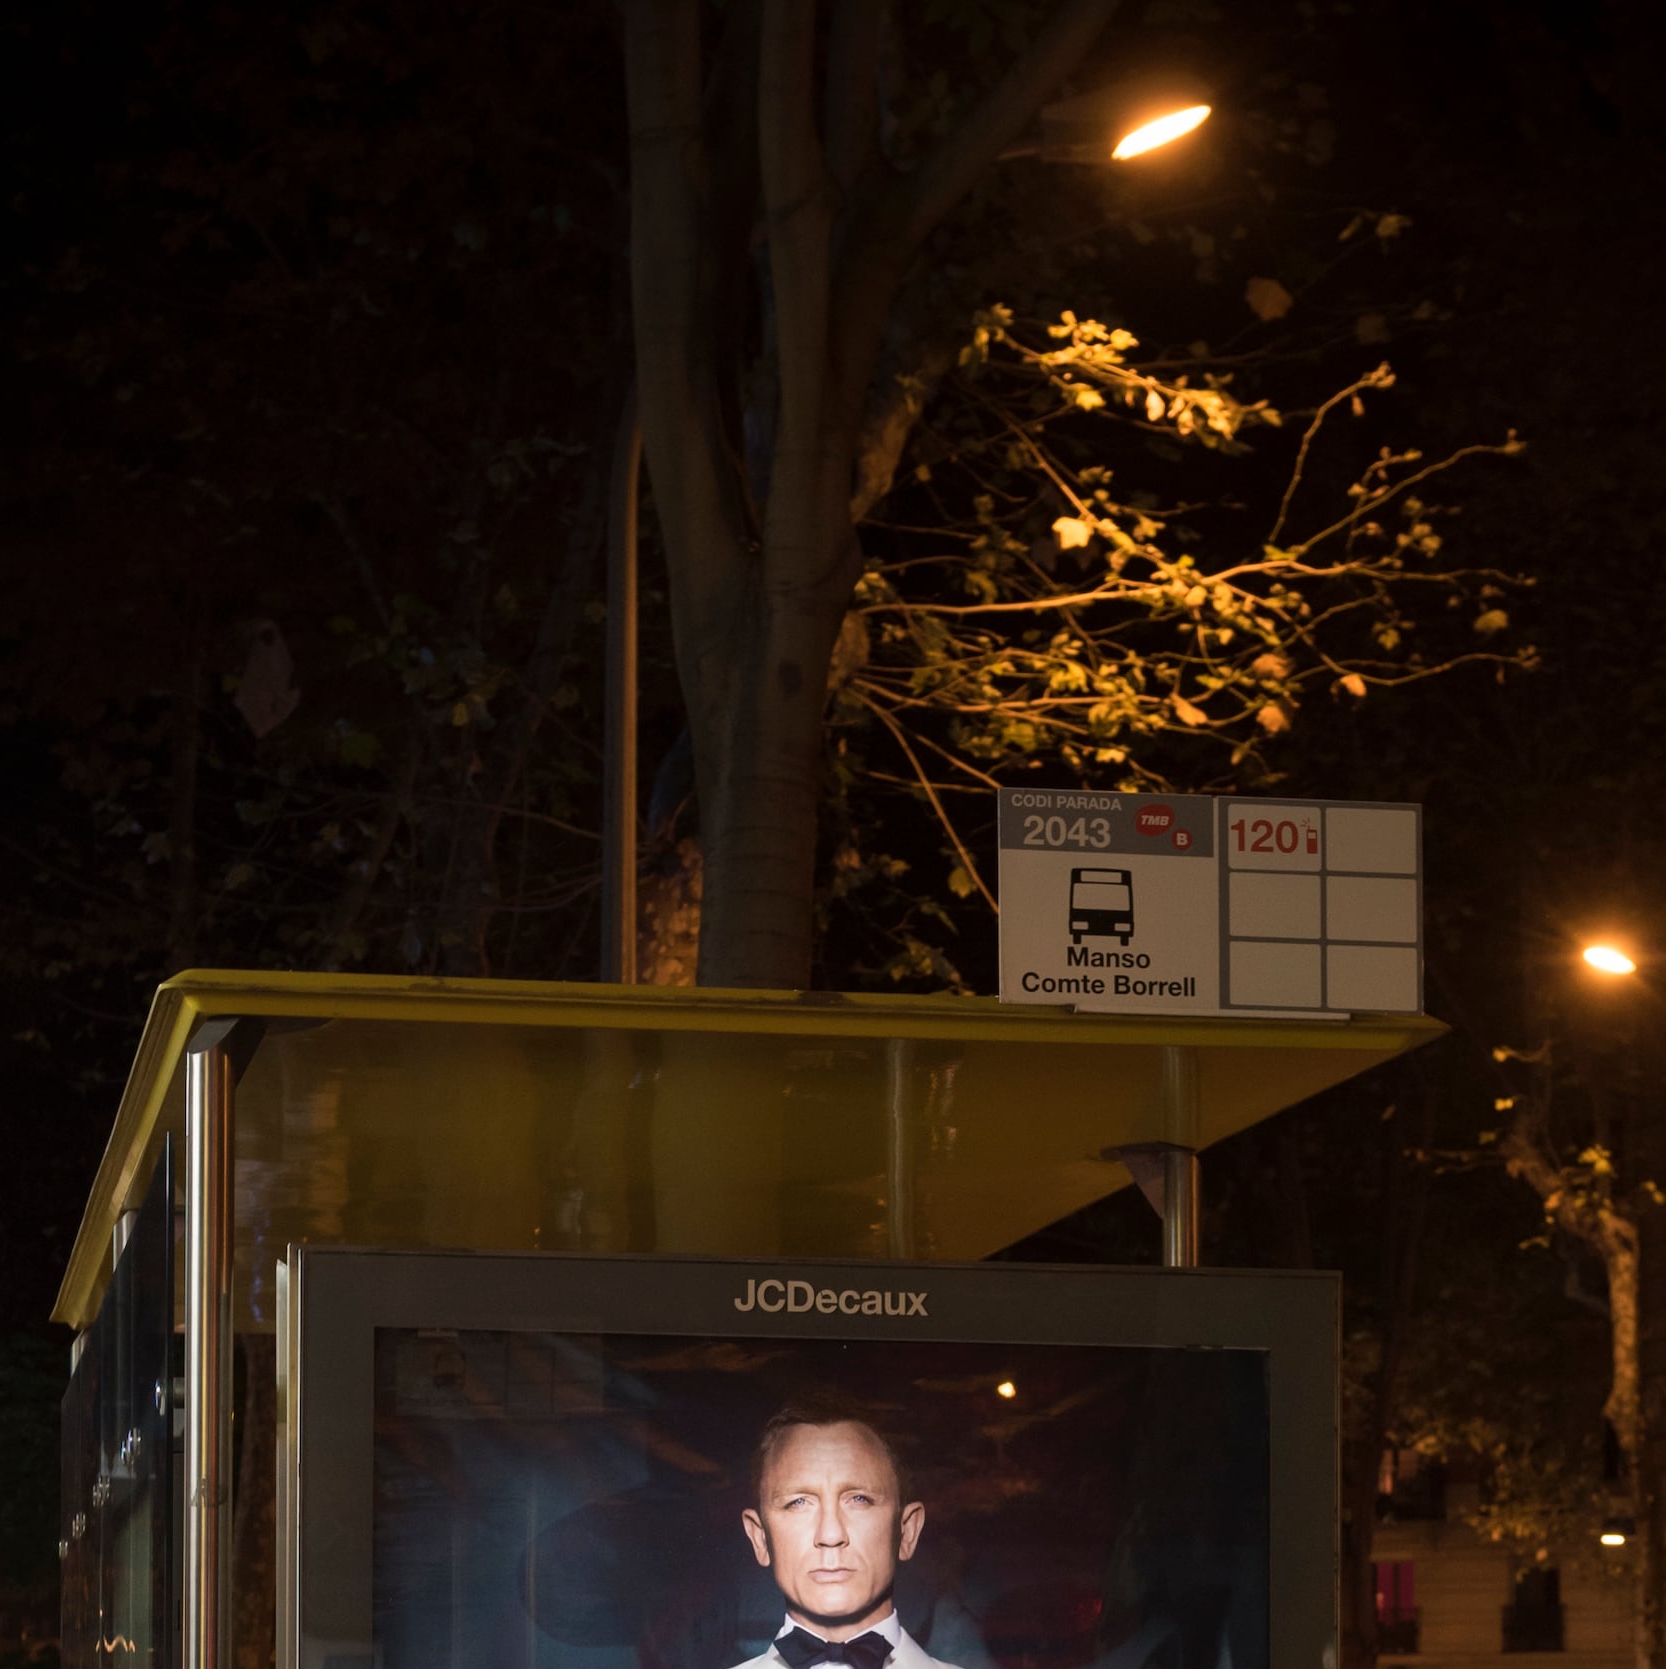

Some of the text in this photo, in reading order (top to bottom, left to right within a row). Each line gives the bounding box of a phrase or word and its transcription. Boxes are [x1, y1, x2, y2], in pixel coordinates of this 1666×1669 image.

[1011, 793, 1123, 812] CODI PARADA
[1022, 815, 1112, 849] 2043
[1140, 814, 1170, 827] TMB
[1230, 819, 1299, 854] 120
[1066, 945, 1151, 970] Manso
[1021, 971, 1196, 998] Comte Borrell
[733, 1278, 930, 1319] JCDecaux
